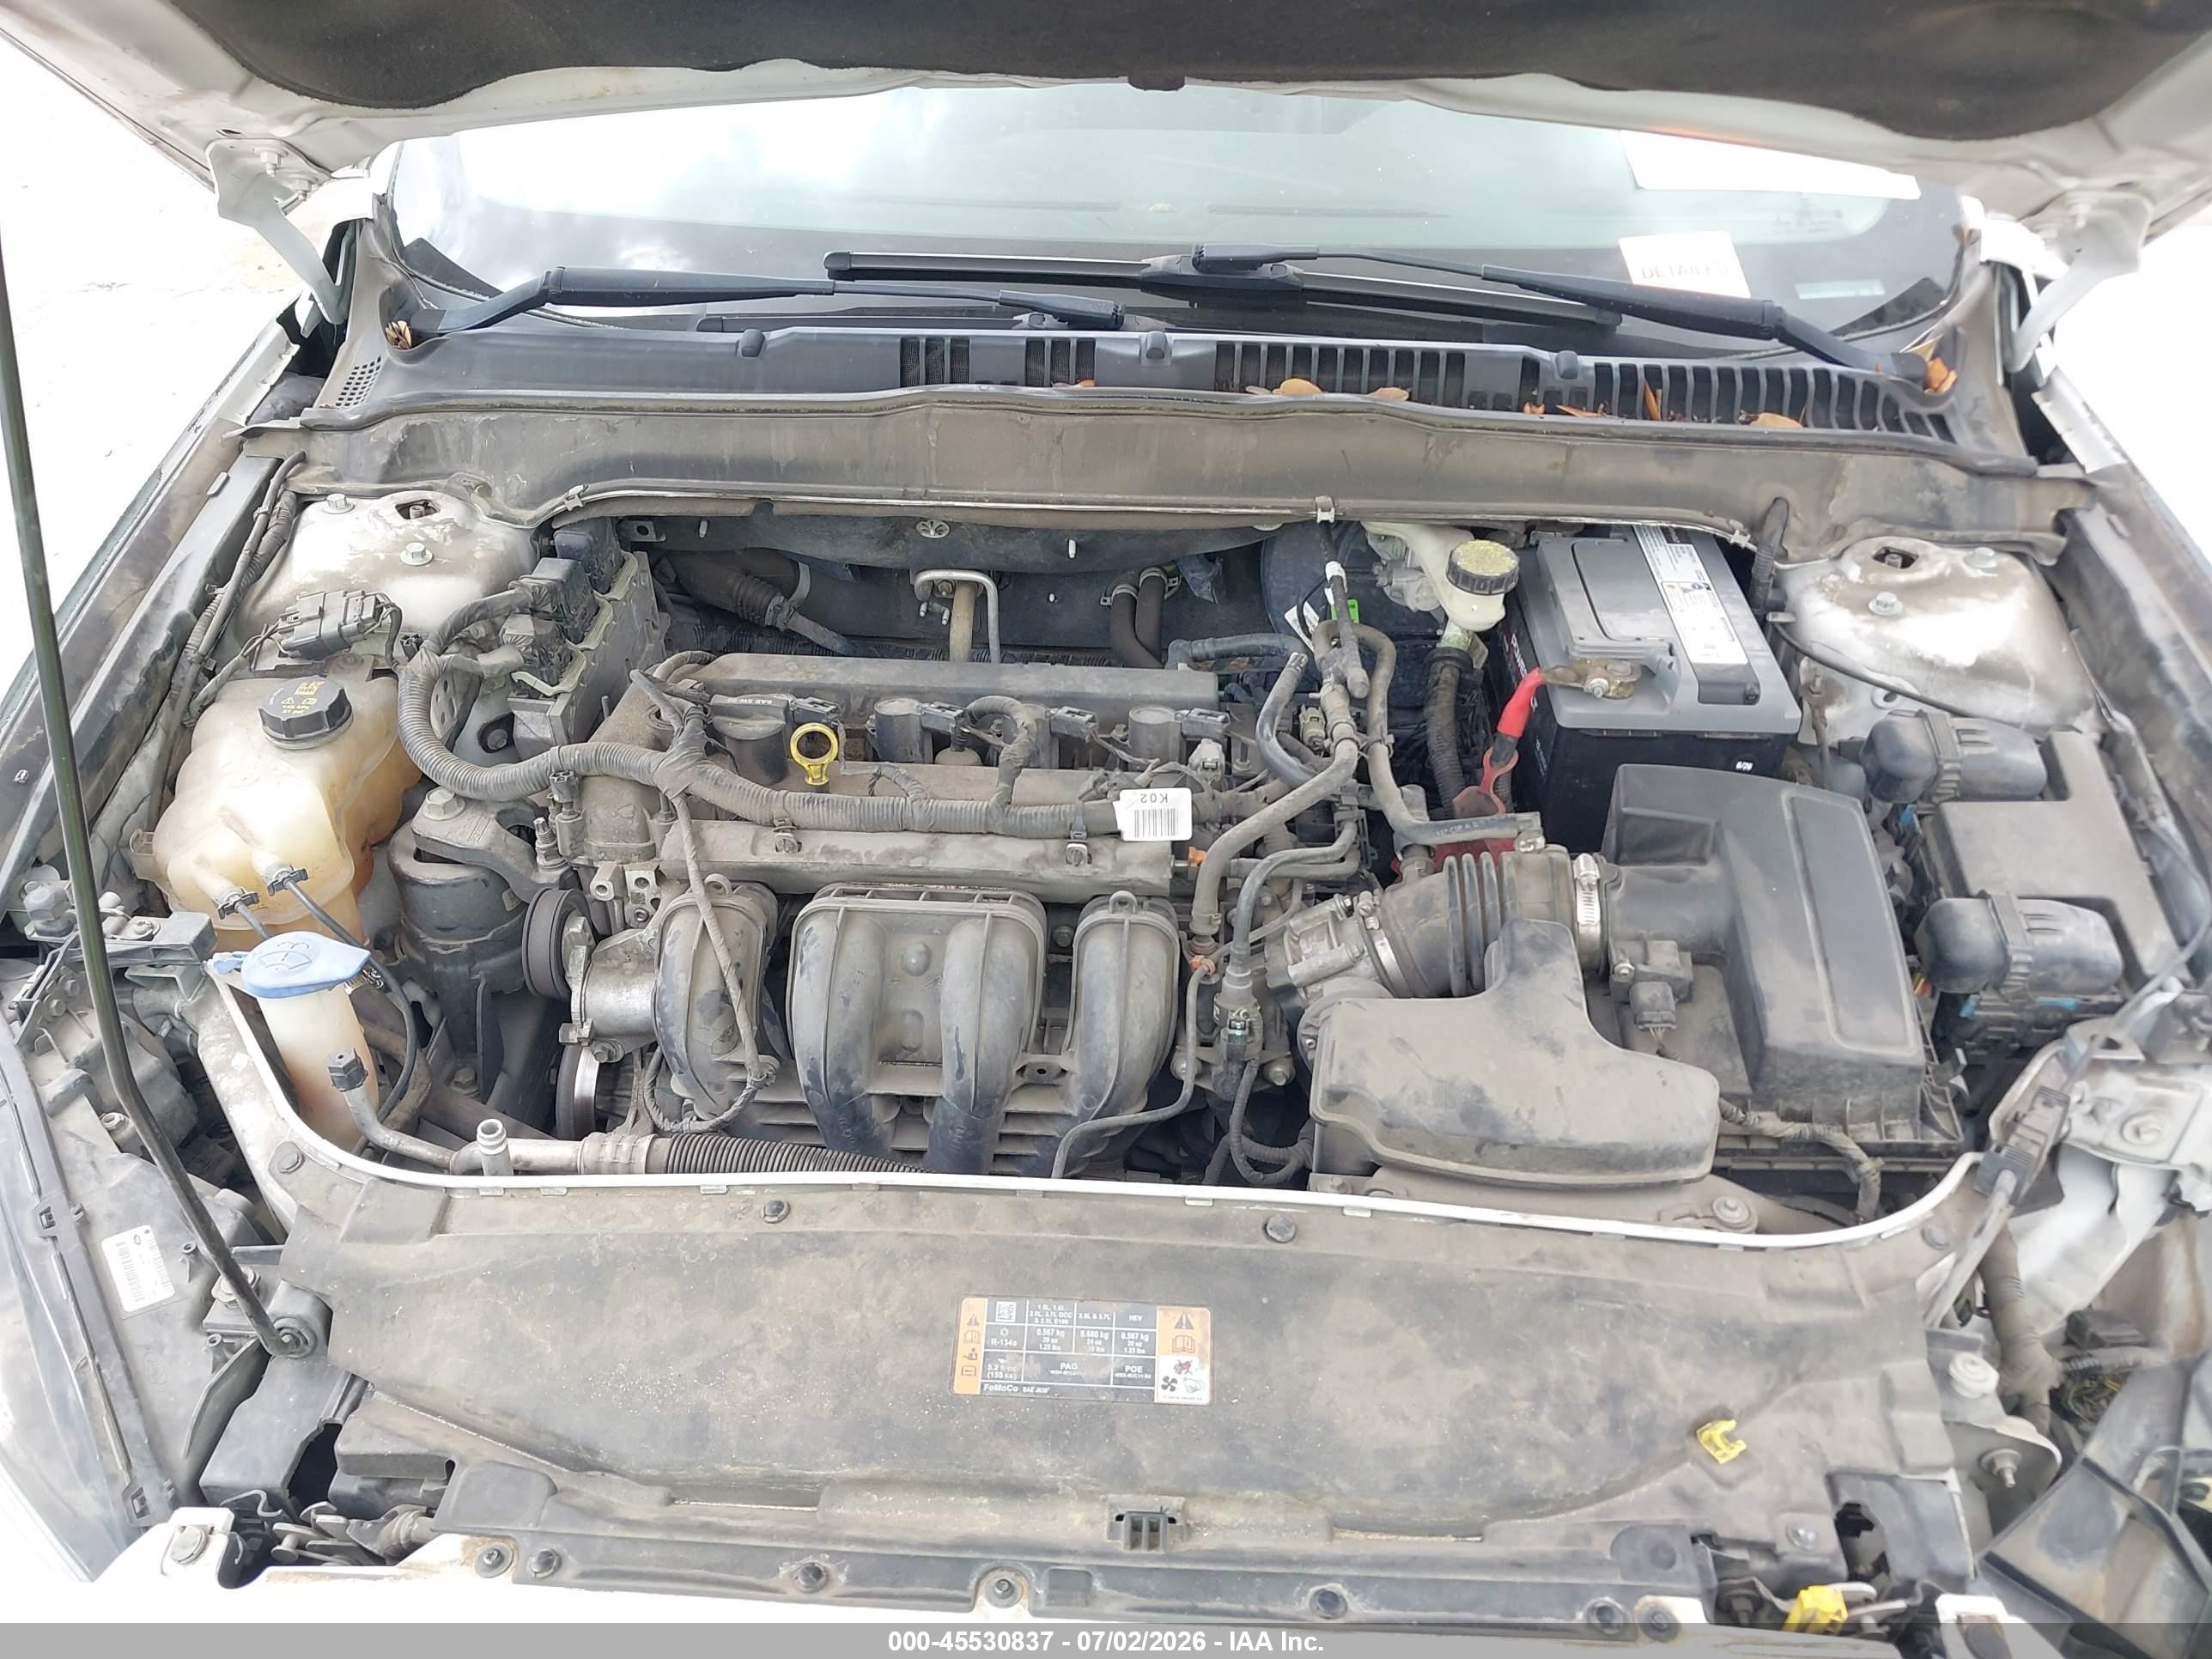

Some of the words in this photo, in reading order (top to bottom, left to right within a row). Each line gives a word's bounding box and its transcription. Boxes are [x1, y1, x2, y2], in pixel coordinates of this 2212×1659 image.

[1140, 793, 1169, 804] K02
[990, 1338, 1018, 1346] R-134a
[1060, 1362, 1079, 1370] PAG
[1125, 1365, 1144, 1374] POE
[983, 1383, 1019, 1392] FoMoCo
